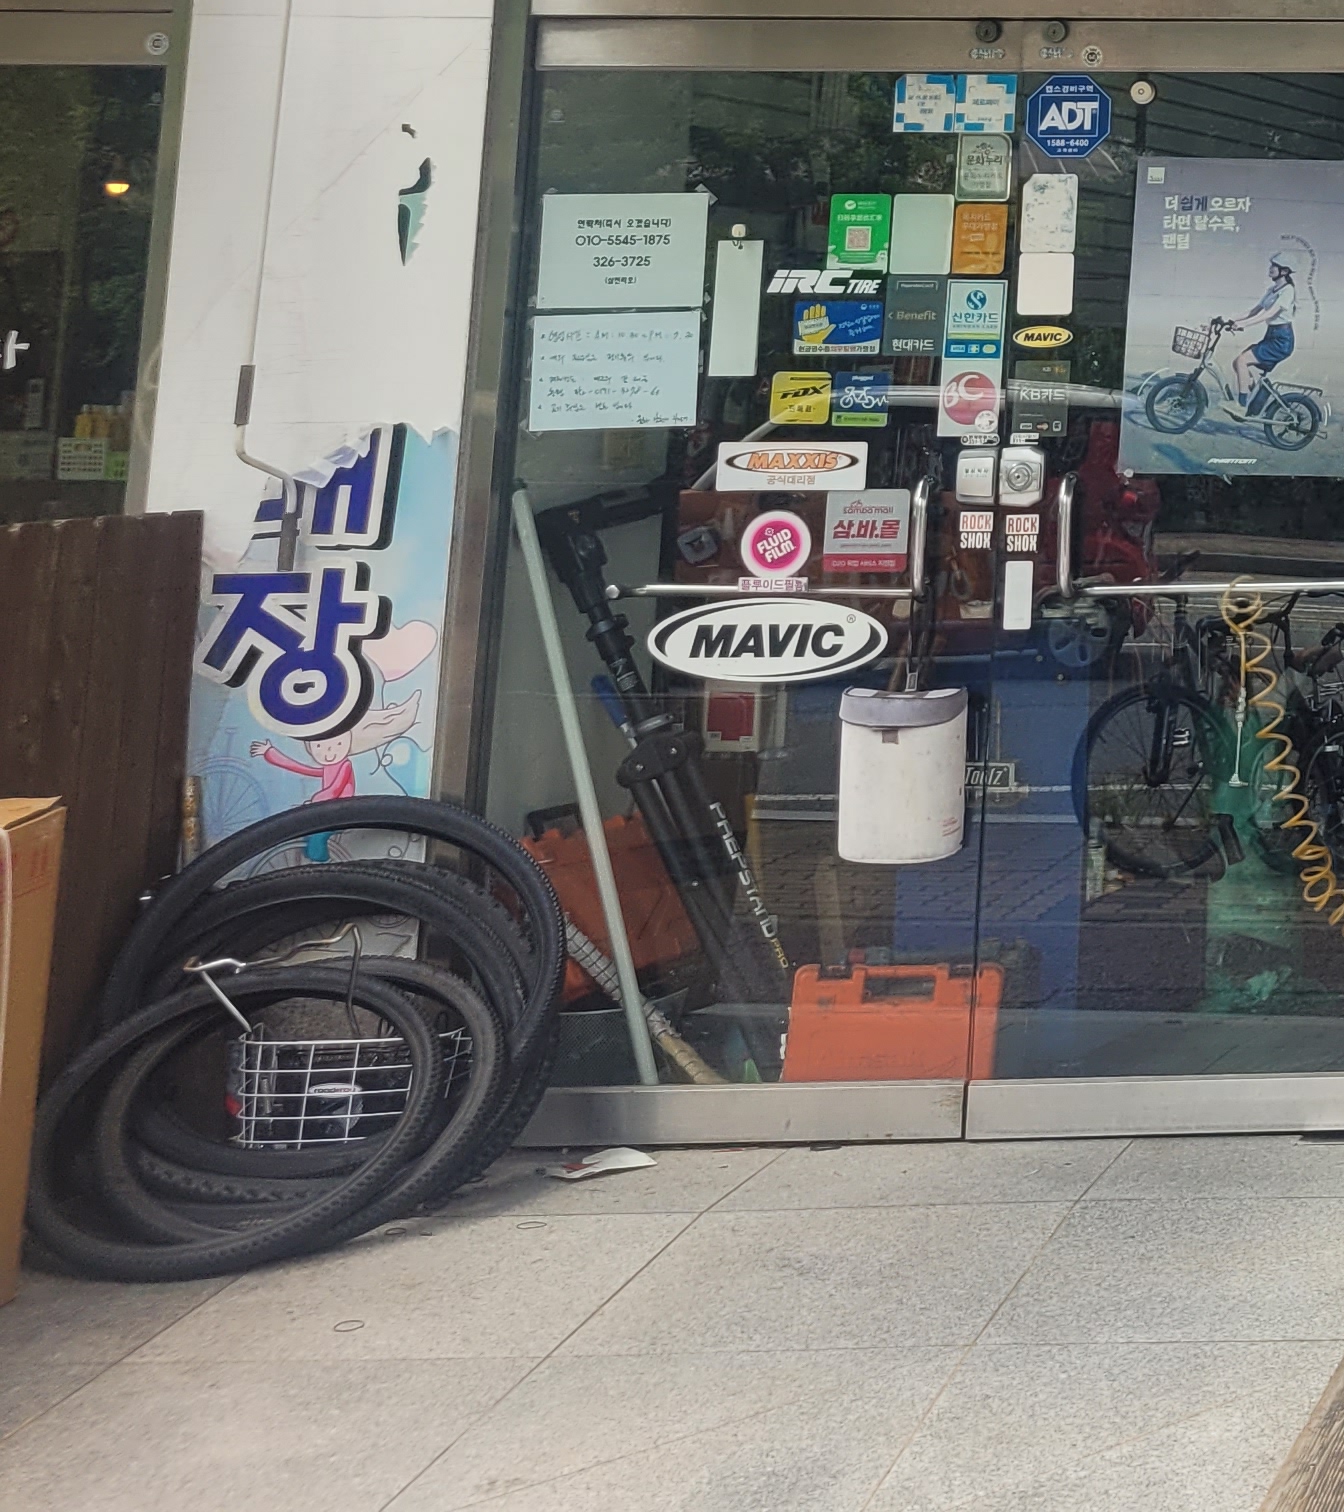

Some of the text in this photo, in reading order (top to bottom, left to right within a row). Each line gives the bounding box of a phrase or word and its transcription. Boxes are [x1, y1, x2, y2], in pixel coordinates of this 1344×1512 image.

[1038, 100, 1099, 131] ADT
[1046, 138, 1089, 147] 1588-6400
[966, 154, 1003, 166] 문화누리
[1165, 195, 1251, 213] 더 쉽게 오르자
[1163, 214, 1191, 230] 타면
[575, 234, 671, 246] 010-5545-1875
[1163, 233, 1190, 249] 팬텀
[593, 256, 652, 267] 326-3725
[846, 280, 882, 294] TIRE
[897, 311, 937, 321] Benefit
[952, 312, 999, 324] 신한카드
[1023, 332, 1063, 342] MAVIC
[892, 339, 935, 352] 현대카드
[944, 374, 984, 408] BC
[1019, 389, 1066, 401] KB카드
[747, 452, 839, 470] MAXXIS
[766, 474, 816, 486] 공식대리점
[961, 514, 992, 530] ROCK
[1007, 516, 1038, 533] ROCK
[756, 528, 793, 555] FLUID
[960, 532, 991, 549] SHOX
[1006, 535, 1037, 553] SHOX
[764, 543, 796, 564] FILM
[688, 623, 846, 659] MAVIC
[709, 801, 789, 969] PREPSTAND PRO
